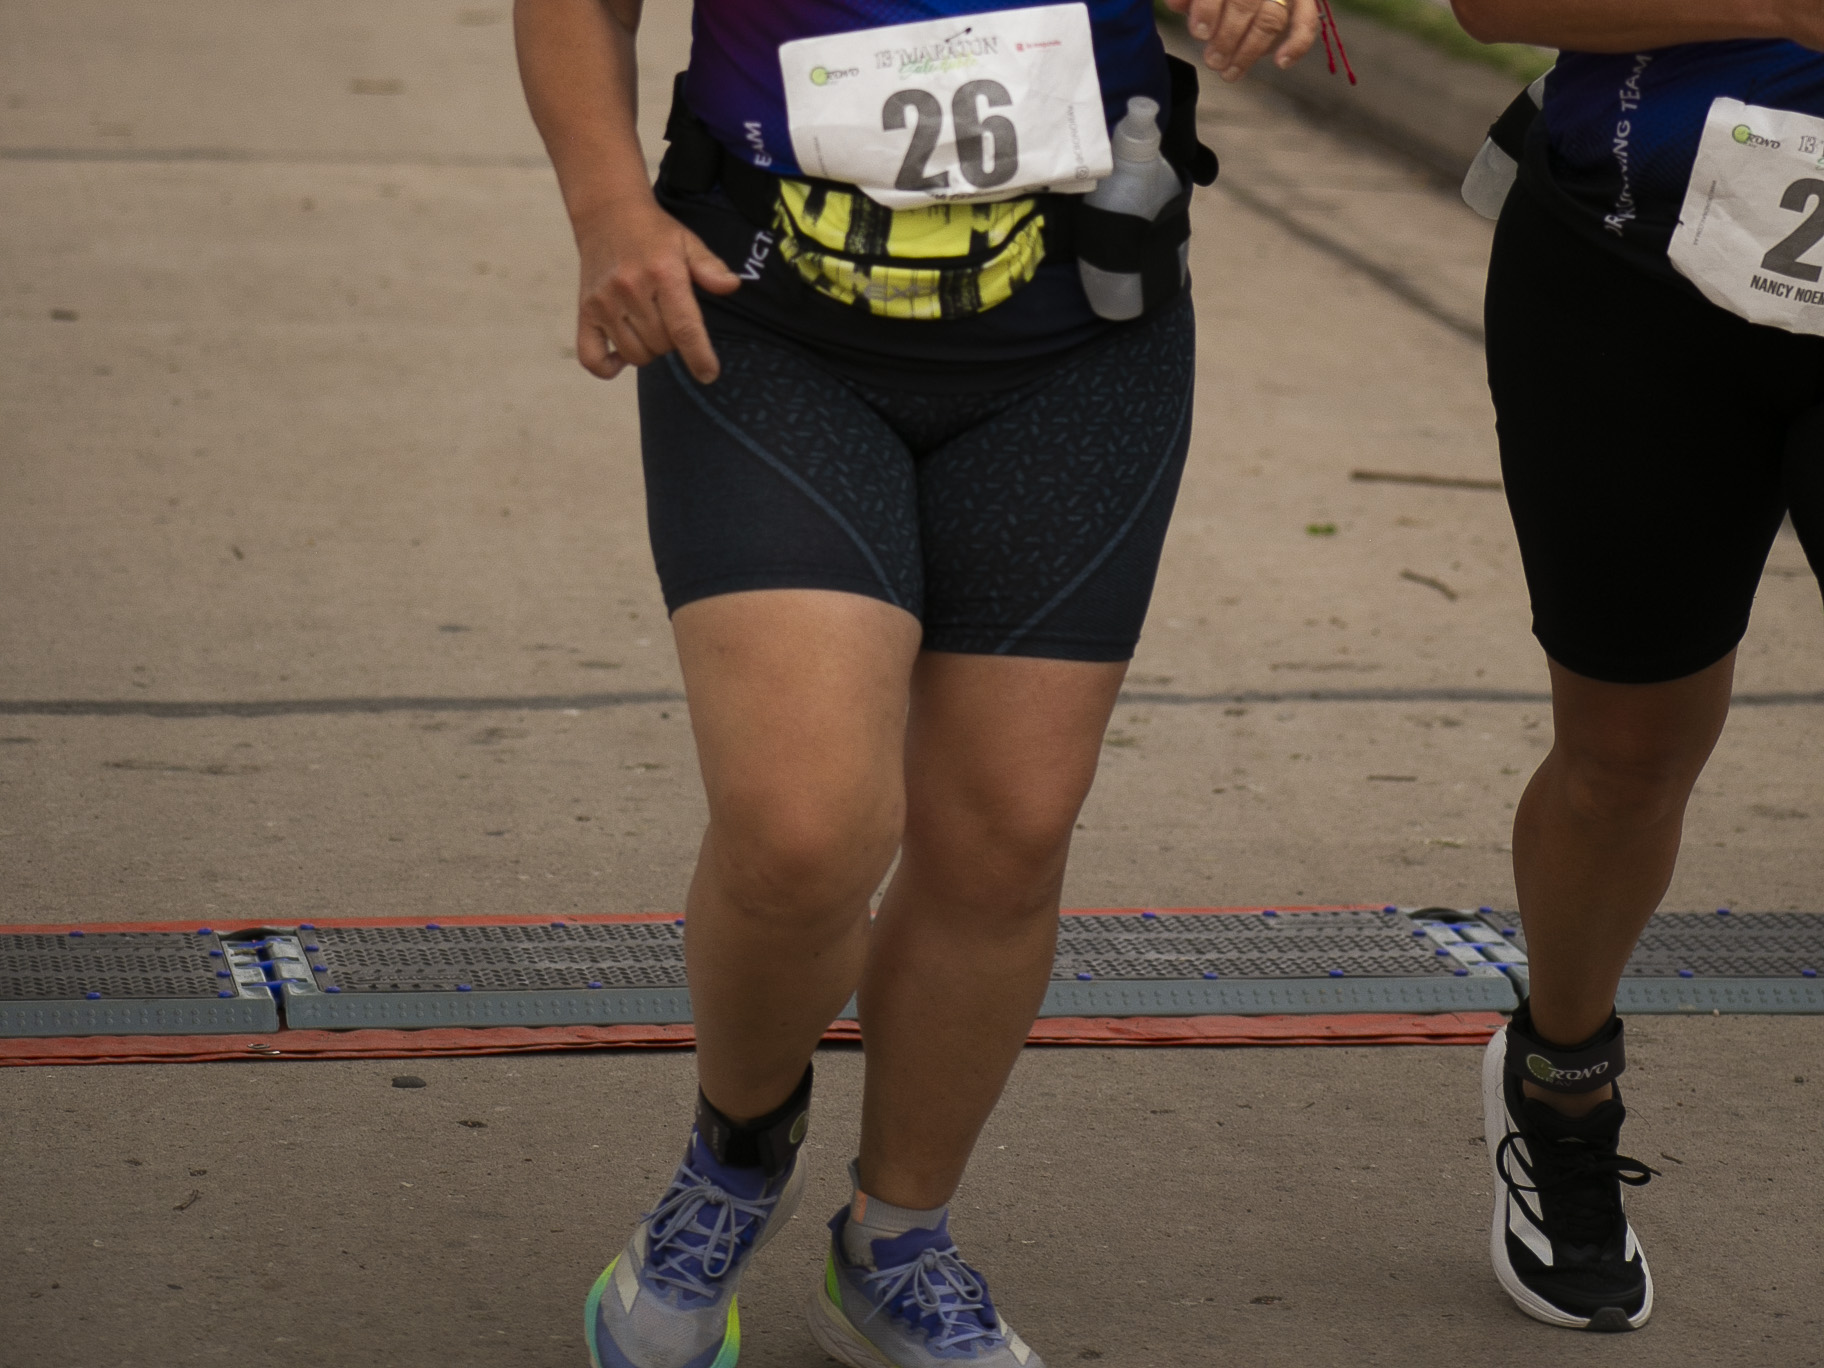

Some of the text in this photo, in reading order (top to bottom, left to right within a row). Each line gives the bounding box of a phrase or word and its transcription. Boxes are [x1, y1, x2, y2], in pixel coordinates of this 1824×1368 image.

[1619, 54, 1653, 112] TEAM
[881, 78, 1018, 191] 26
[738, 231, 774, 280] VICT
[1750, 274, 1794, 299] NANCY
